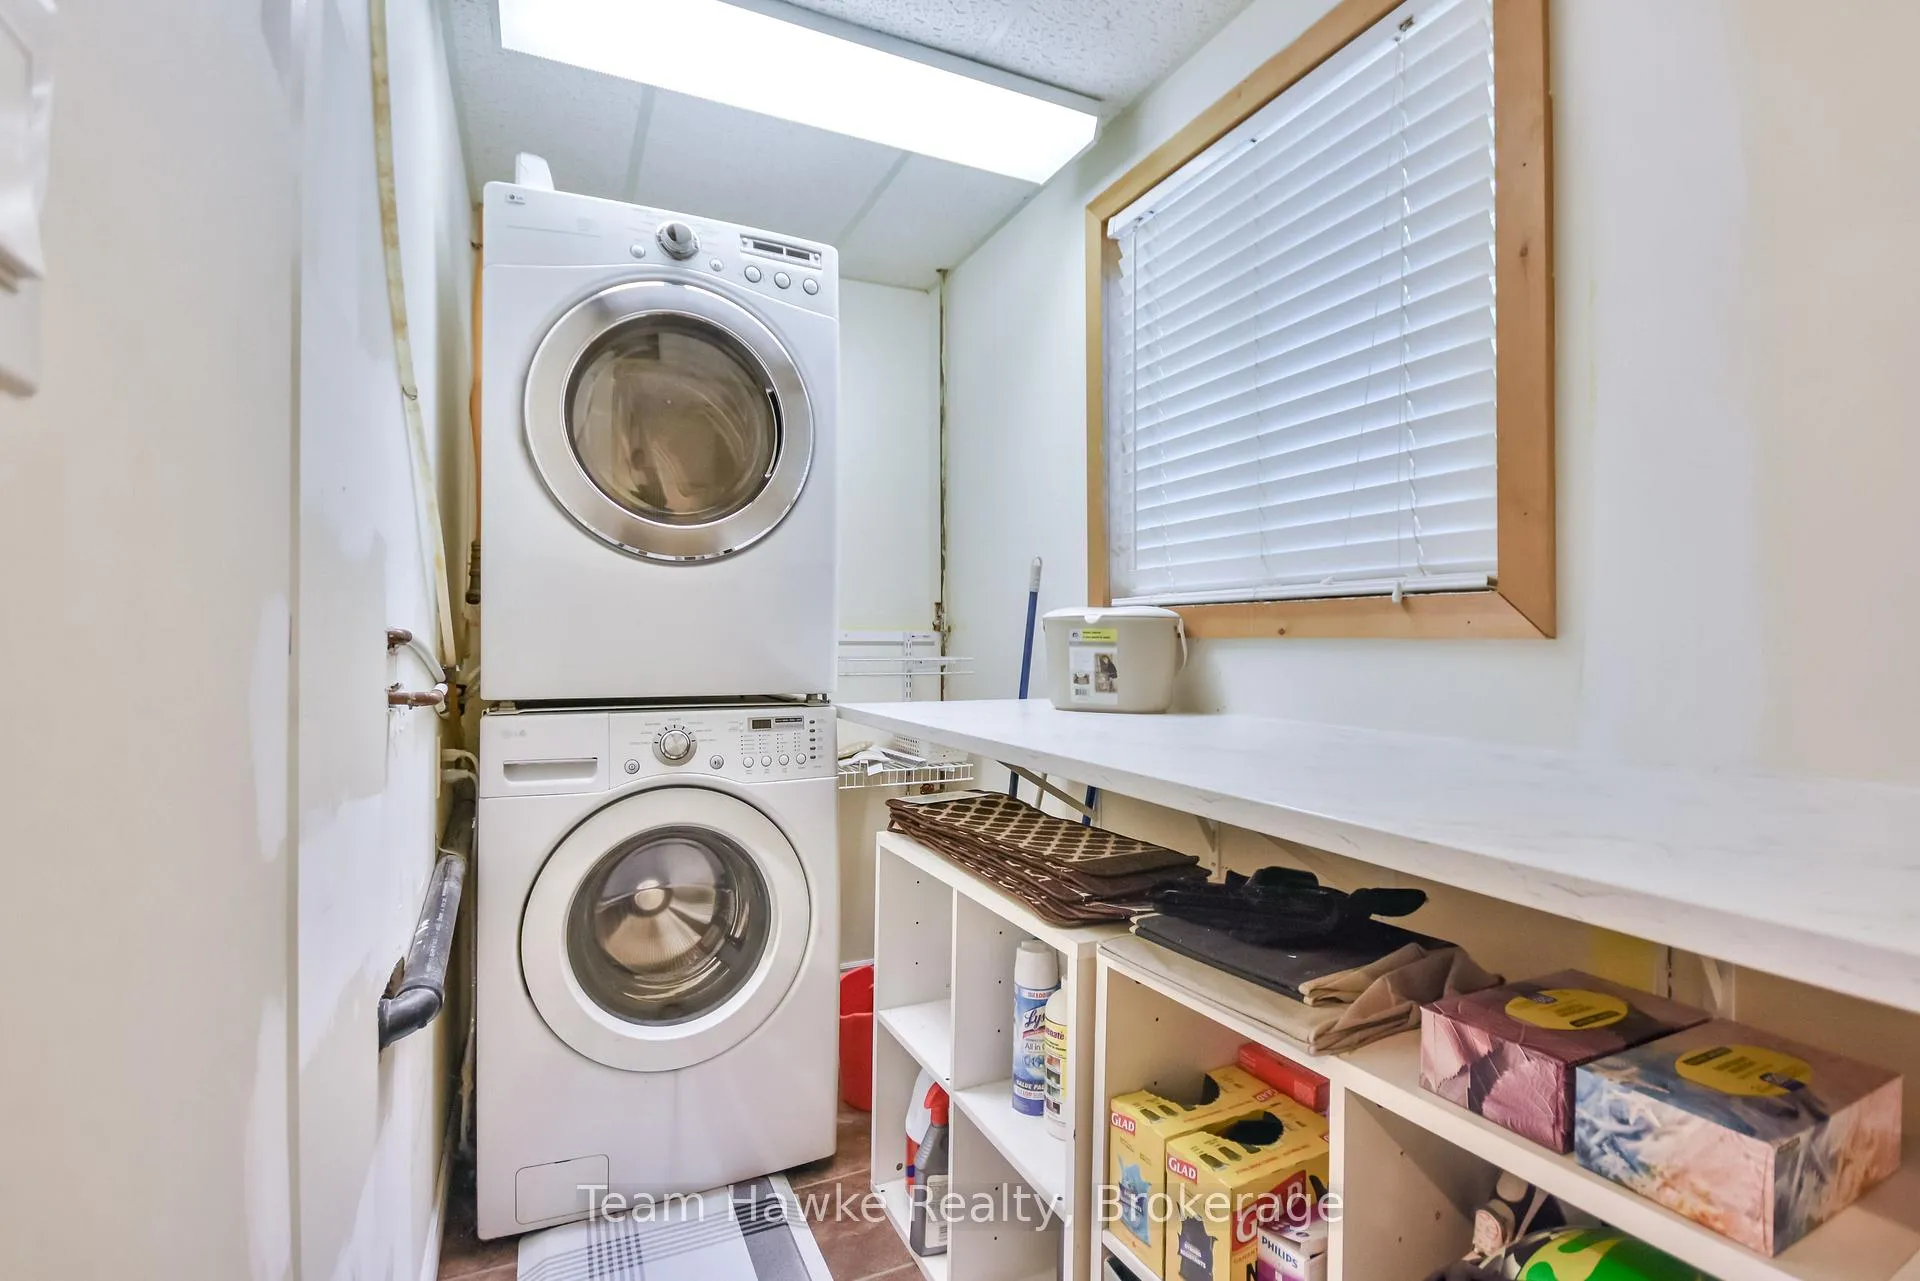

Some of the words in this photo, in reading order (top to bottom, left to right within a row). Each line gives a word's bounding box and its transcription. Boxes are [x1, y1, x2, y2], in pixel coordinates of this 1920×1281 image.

[1111, 1112, 1135, 1132] GLAD
[1168, 1157, 1196, 1180] GLAD
[1261, 1236, 1299, 1269] PHILIPS
